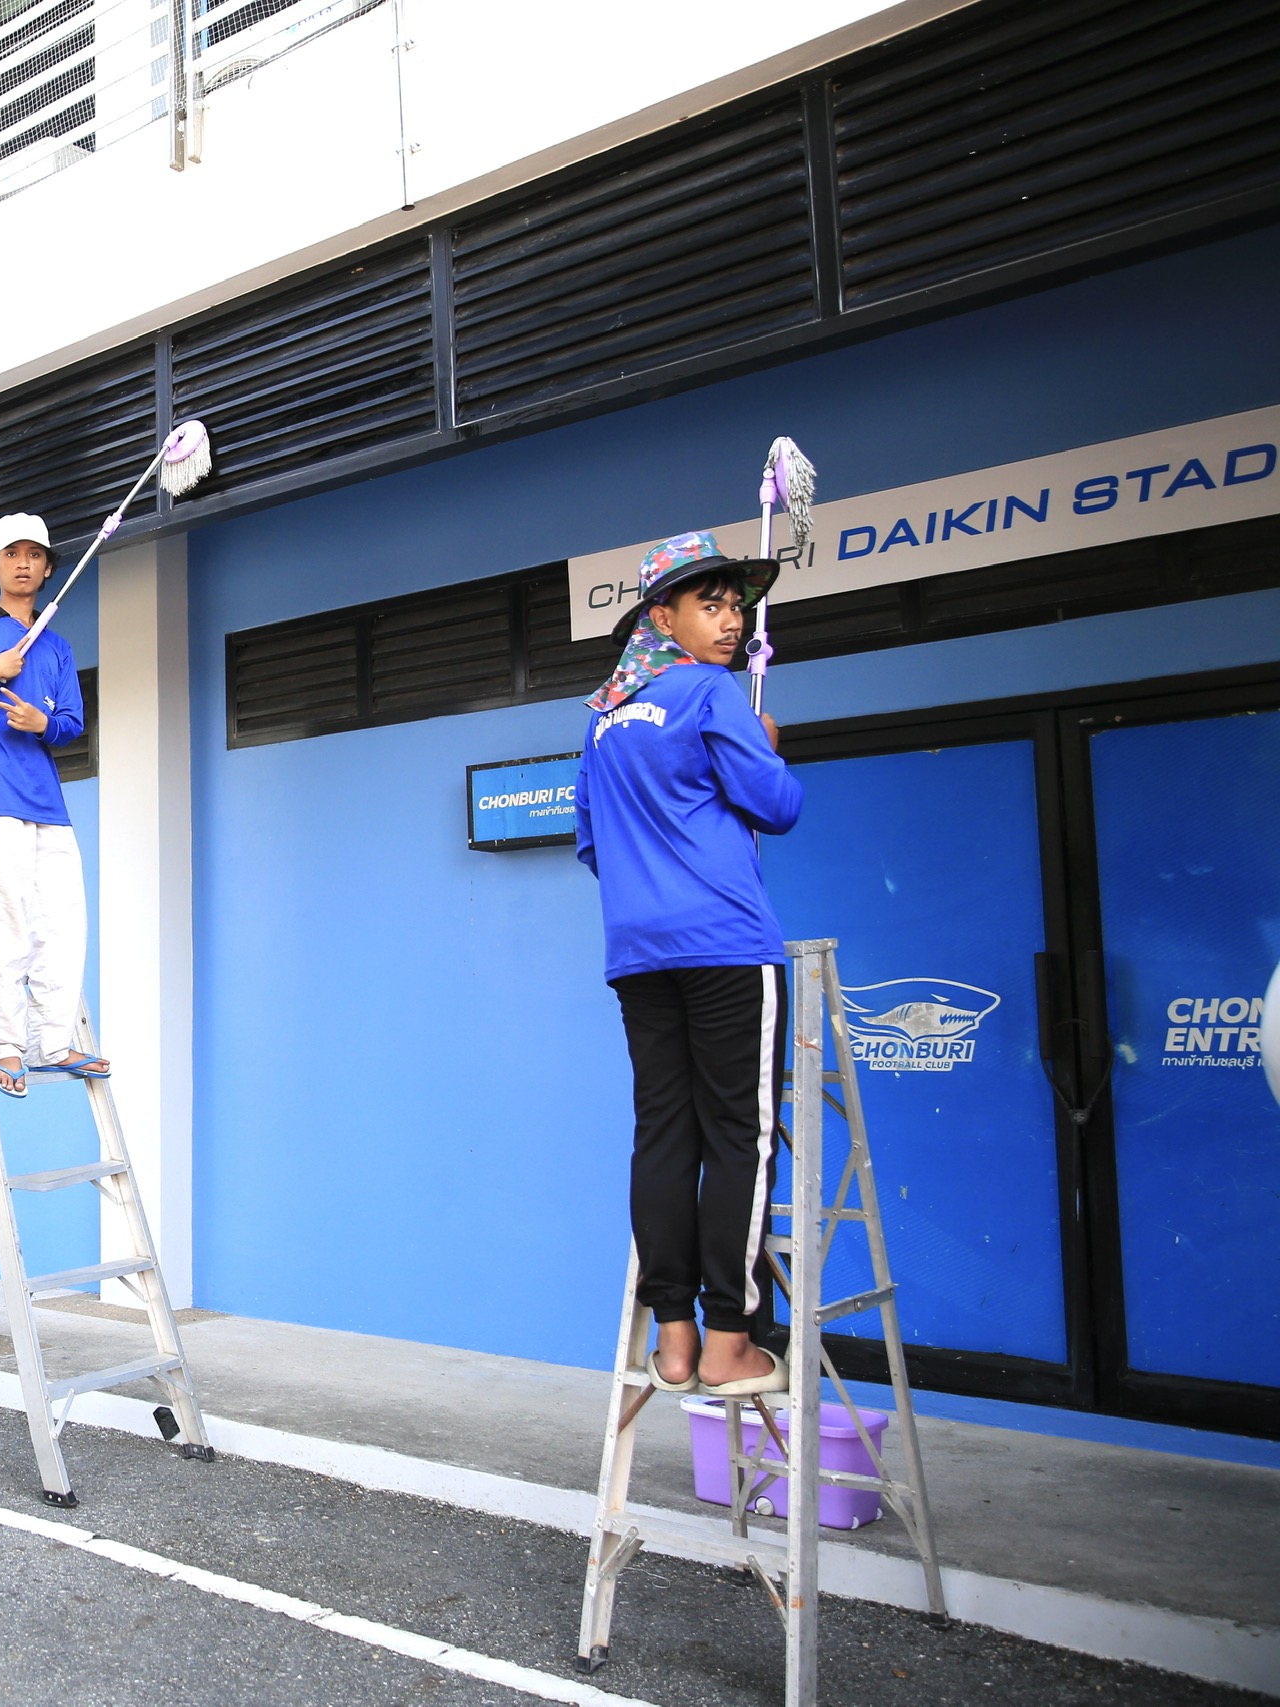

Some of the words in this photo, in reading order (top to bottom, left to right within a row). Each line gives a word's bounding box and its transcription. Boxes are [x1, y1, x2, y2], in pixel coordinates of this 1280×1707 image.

[837, 487, 1050, 561] DAIKIN
[1073, 443, 1278, 515] STAD
[478, 788, 554, 810] CHONBURI
[851, 1040, 973, 1060] CHONBURI
[1164, 1027, 1262, 1052] ENTR
[871, 1060, 923, 1070] FOOTBALL
[924, 1060, 951, 1070] CLUB
